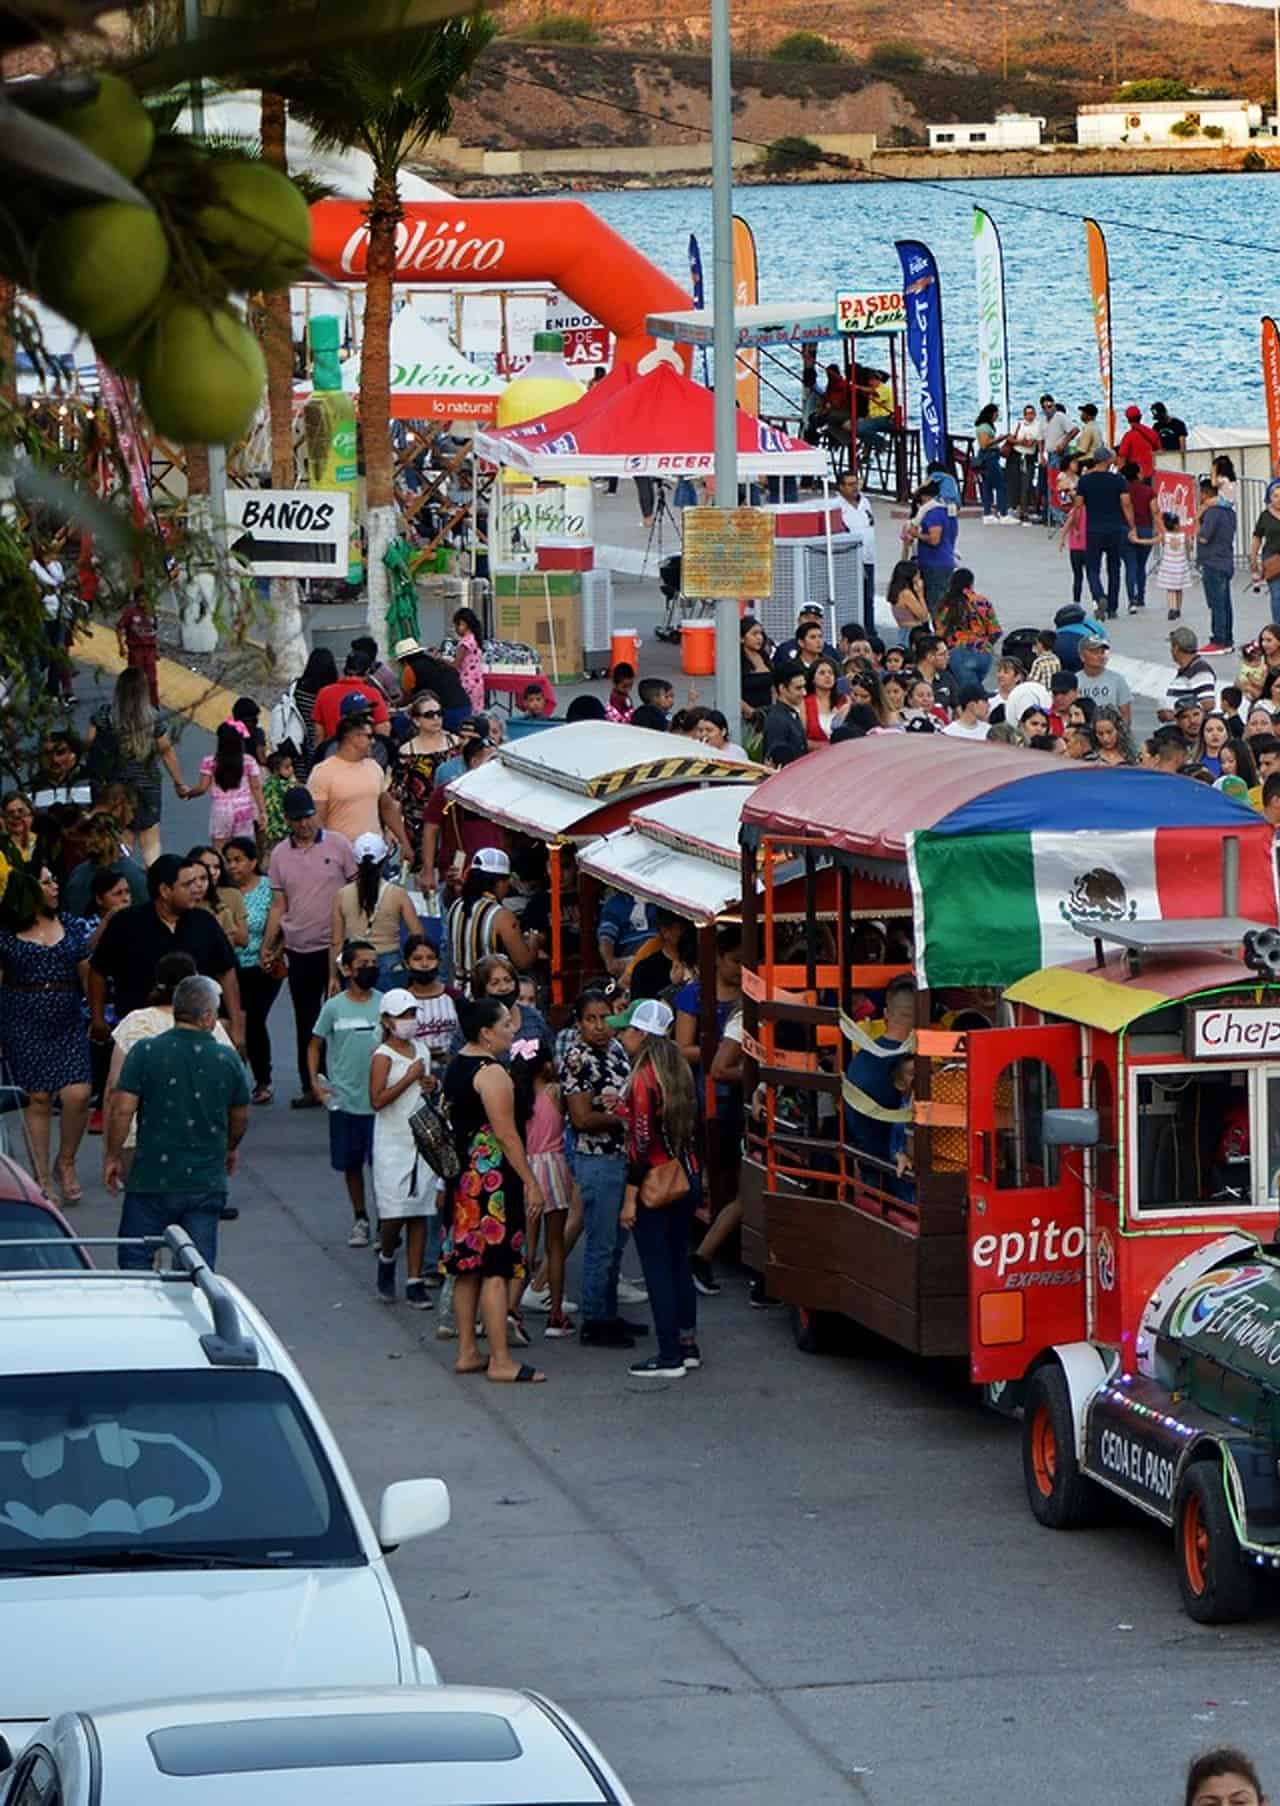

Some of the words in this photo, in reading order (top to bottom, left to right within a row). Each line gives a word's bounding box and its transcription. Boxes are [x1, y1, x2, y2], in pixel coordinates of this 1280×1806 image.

[838, 293, 906, 319] PASEO
[863, 308, 905, 330] Lanch
[242, 500, 335, 531] BAÑOS
[972, 1217, 1085, 1277] epito
[1101, 1428, 1130, 1477] CEDA
[1130, 1442, 1145, 1484] EL
[1144, 1450, 1174, 1500] PASO
